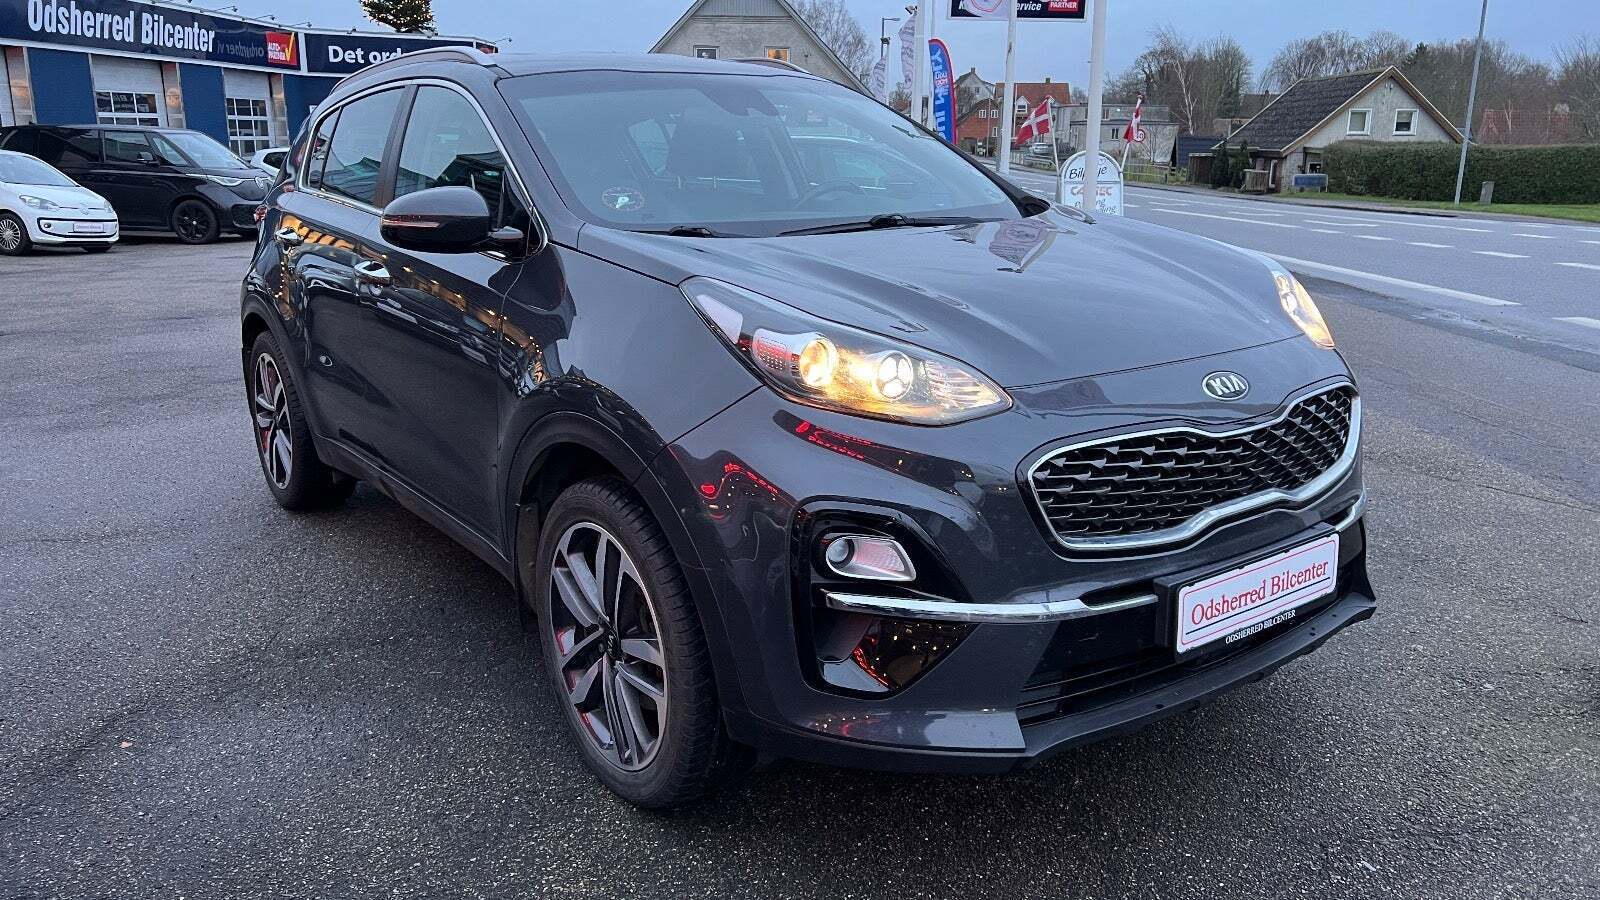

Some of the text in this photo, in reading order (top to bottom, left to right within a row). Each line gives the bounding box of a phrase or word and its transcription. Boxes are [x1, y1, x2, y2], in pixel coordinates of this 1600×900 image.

[1017, 2, 1041, 11] ervice
[1050, 1, 1077, 9] PARTNER
[27, 0, 216, 52] Odsherred Bilcenter
[328, 45, 402, 64] Det ord
[1207, 374, 1247, 396] KIA
[1191, 560, 1329, 625] Odsherred Bilcenter
[1225, 609, 1296, 645] ODSHERRED BILCENTER
